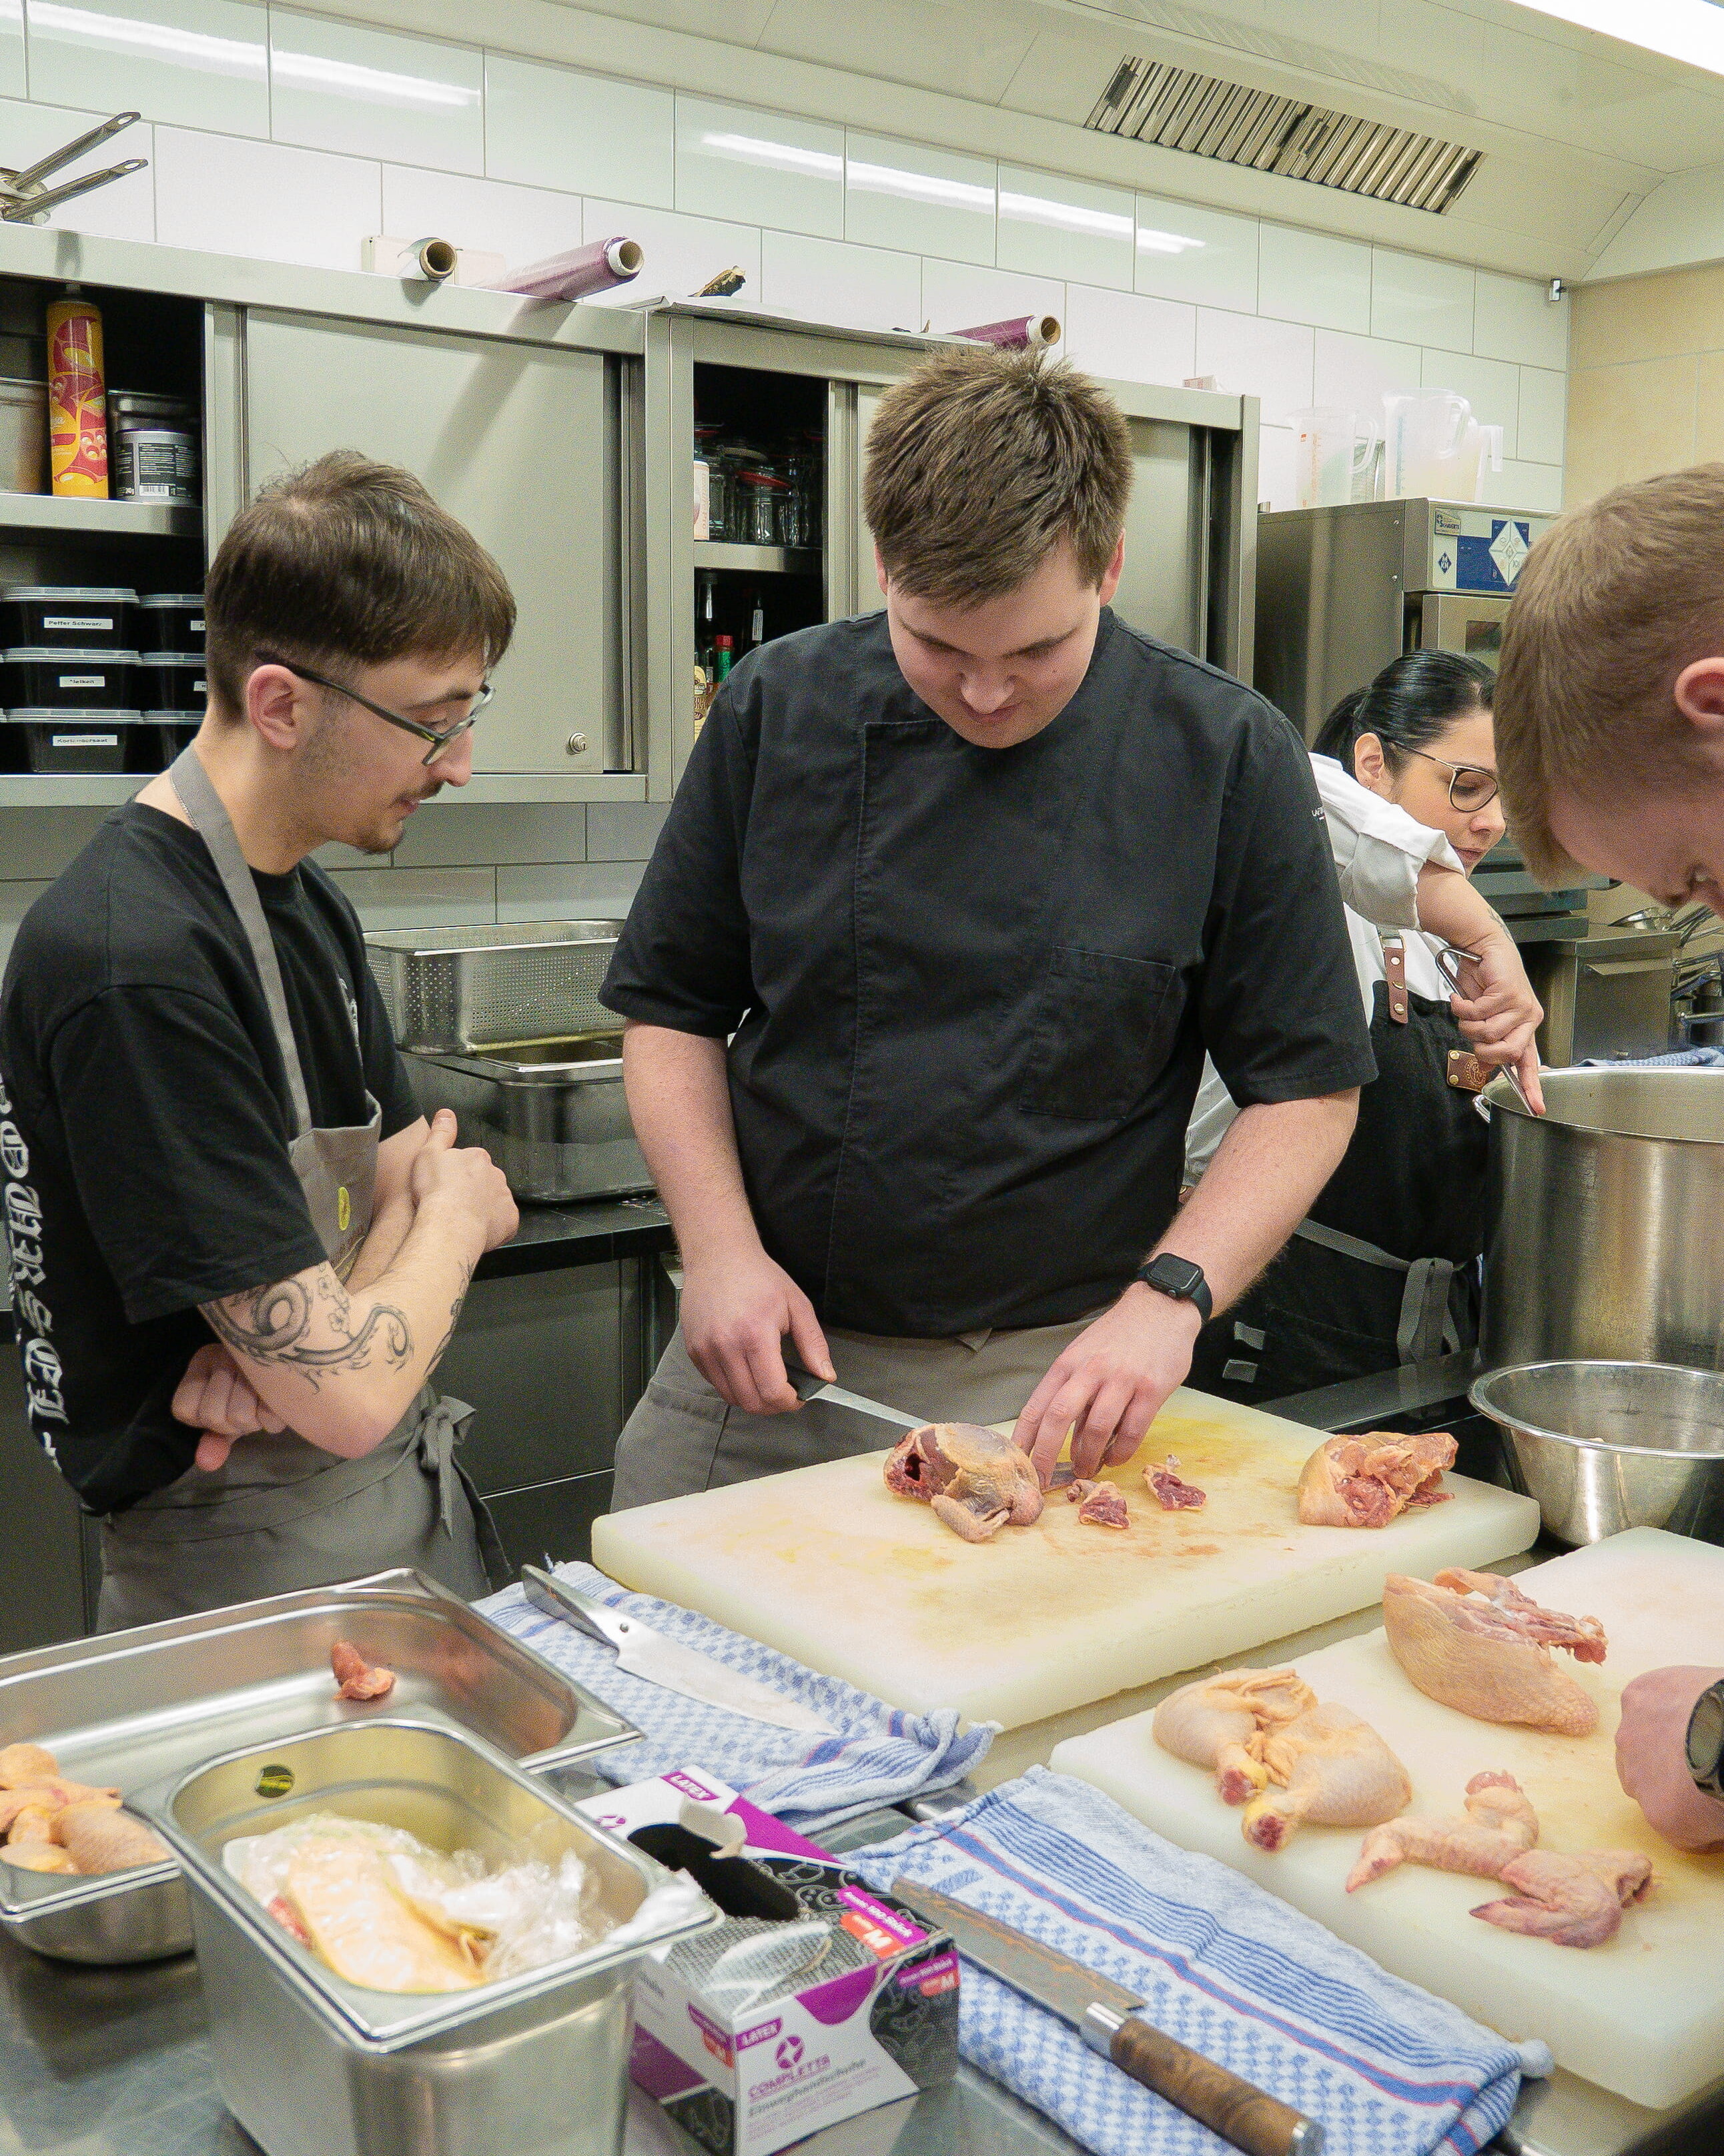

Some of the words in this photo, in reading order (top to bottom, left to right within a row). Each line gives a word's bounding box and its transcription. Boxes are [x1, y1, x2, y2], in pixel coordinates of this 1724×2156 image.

[671, 1774, 711, 1800] LATEX
[863, 1928, 893, 1949] M
[941, 1973, 955, 1988] M
